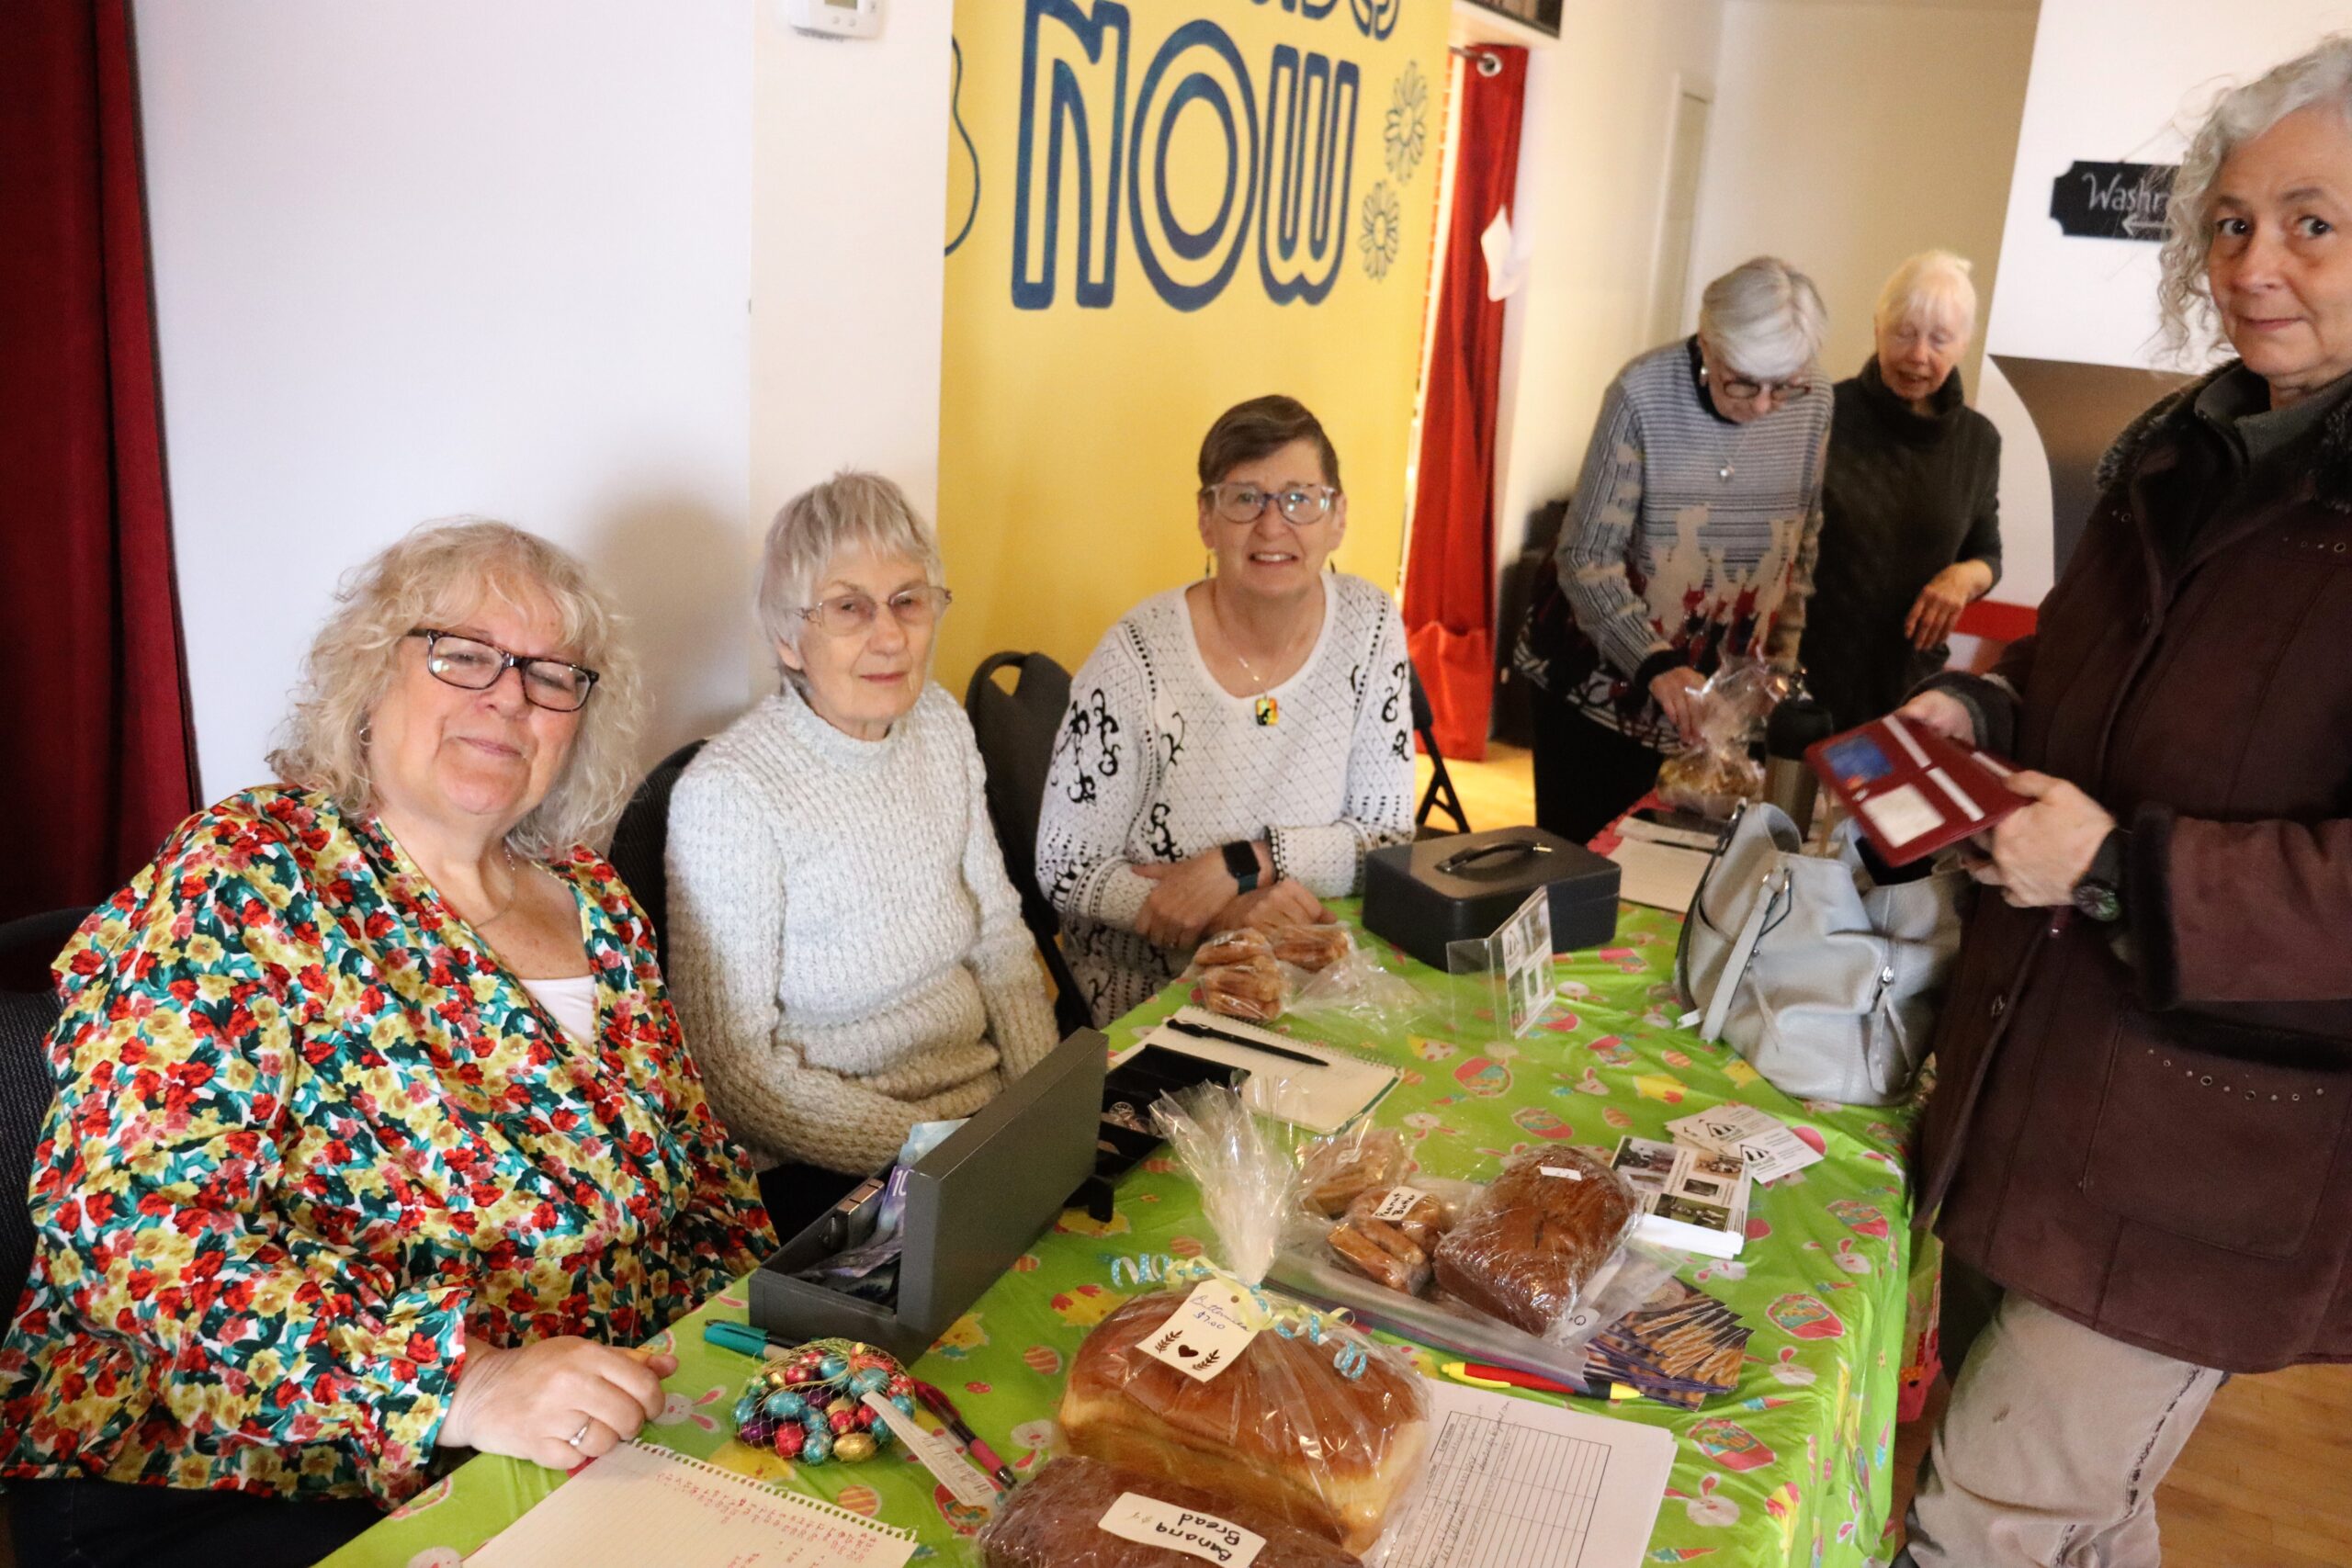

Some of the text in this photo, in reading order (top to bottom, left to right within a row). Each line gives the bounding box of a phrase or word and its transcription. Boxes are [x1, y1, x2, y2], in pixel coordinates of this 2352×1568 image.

[1012, 0, 1360, 312] NOW
[2082, 173, 2170, 211] Washr
[1155, 1521, 1233, 1562] Banana
[1177, 1512, 1241, 1546] Bread
